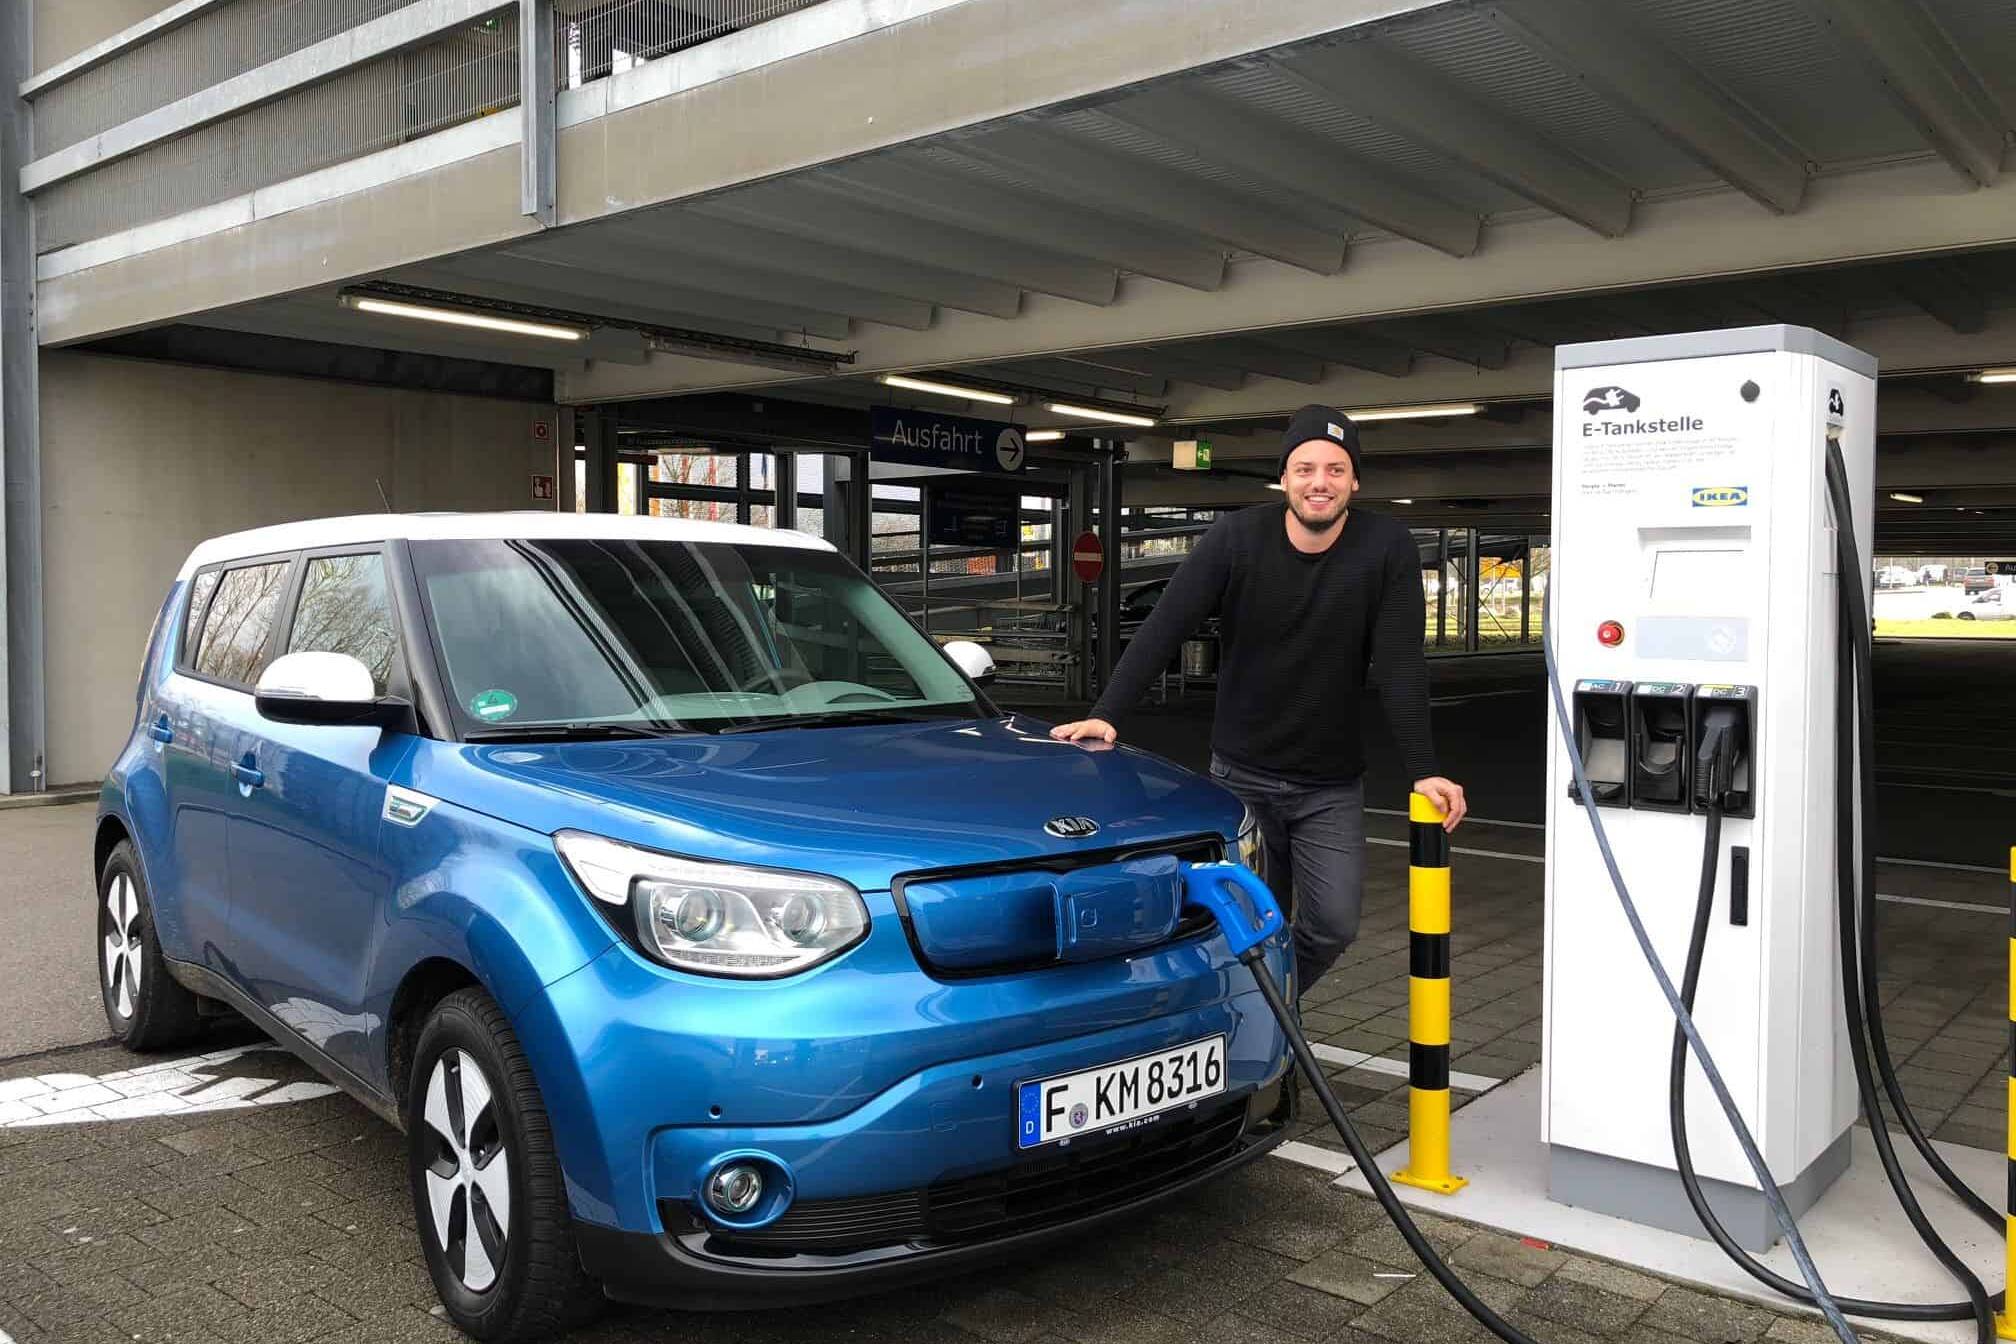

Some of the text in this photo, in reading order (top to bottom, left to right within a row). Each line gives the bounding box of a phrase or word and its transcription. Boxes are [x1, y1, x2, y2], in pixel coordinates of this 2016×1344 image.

[1582, 416, 1704, 437] E-Tankstelle
[892, 419, 984, 455] Ausfahrt
[1699, 491, 1742, 502] IKEA
[1674, 684, 1685, 694] 2
[1736, 687, 1746, 697] 3
[1050, 817, 1095, 834] KIA
[1046, 1045, 1220, 1132] F KM 8316
[1025, 1120, 1034, 1134] D
